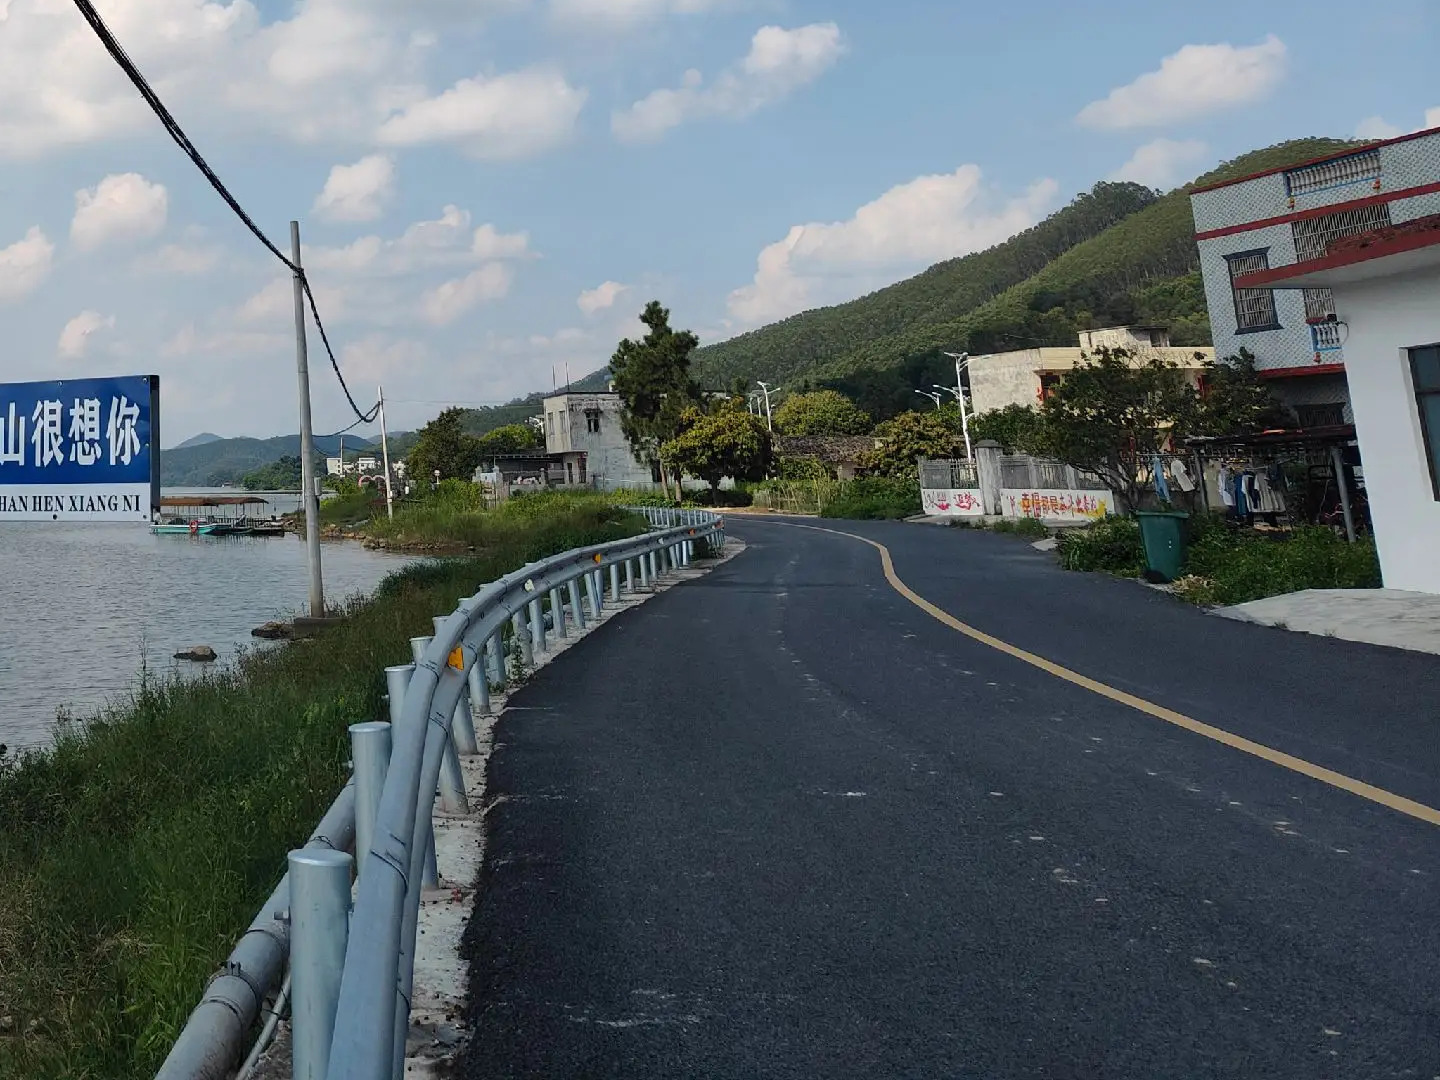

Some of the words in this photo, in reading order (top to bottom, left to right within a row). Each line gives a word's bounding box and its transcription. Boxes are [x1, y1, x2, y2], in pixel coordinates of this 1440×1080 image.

[32, 495, 64, 512] HEN
[68, 495, 118, 512] XIANG
[122, 495, 141, 512] NI
